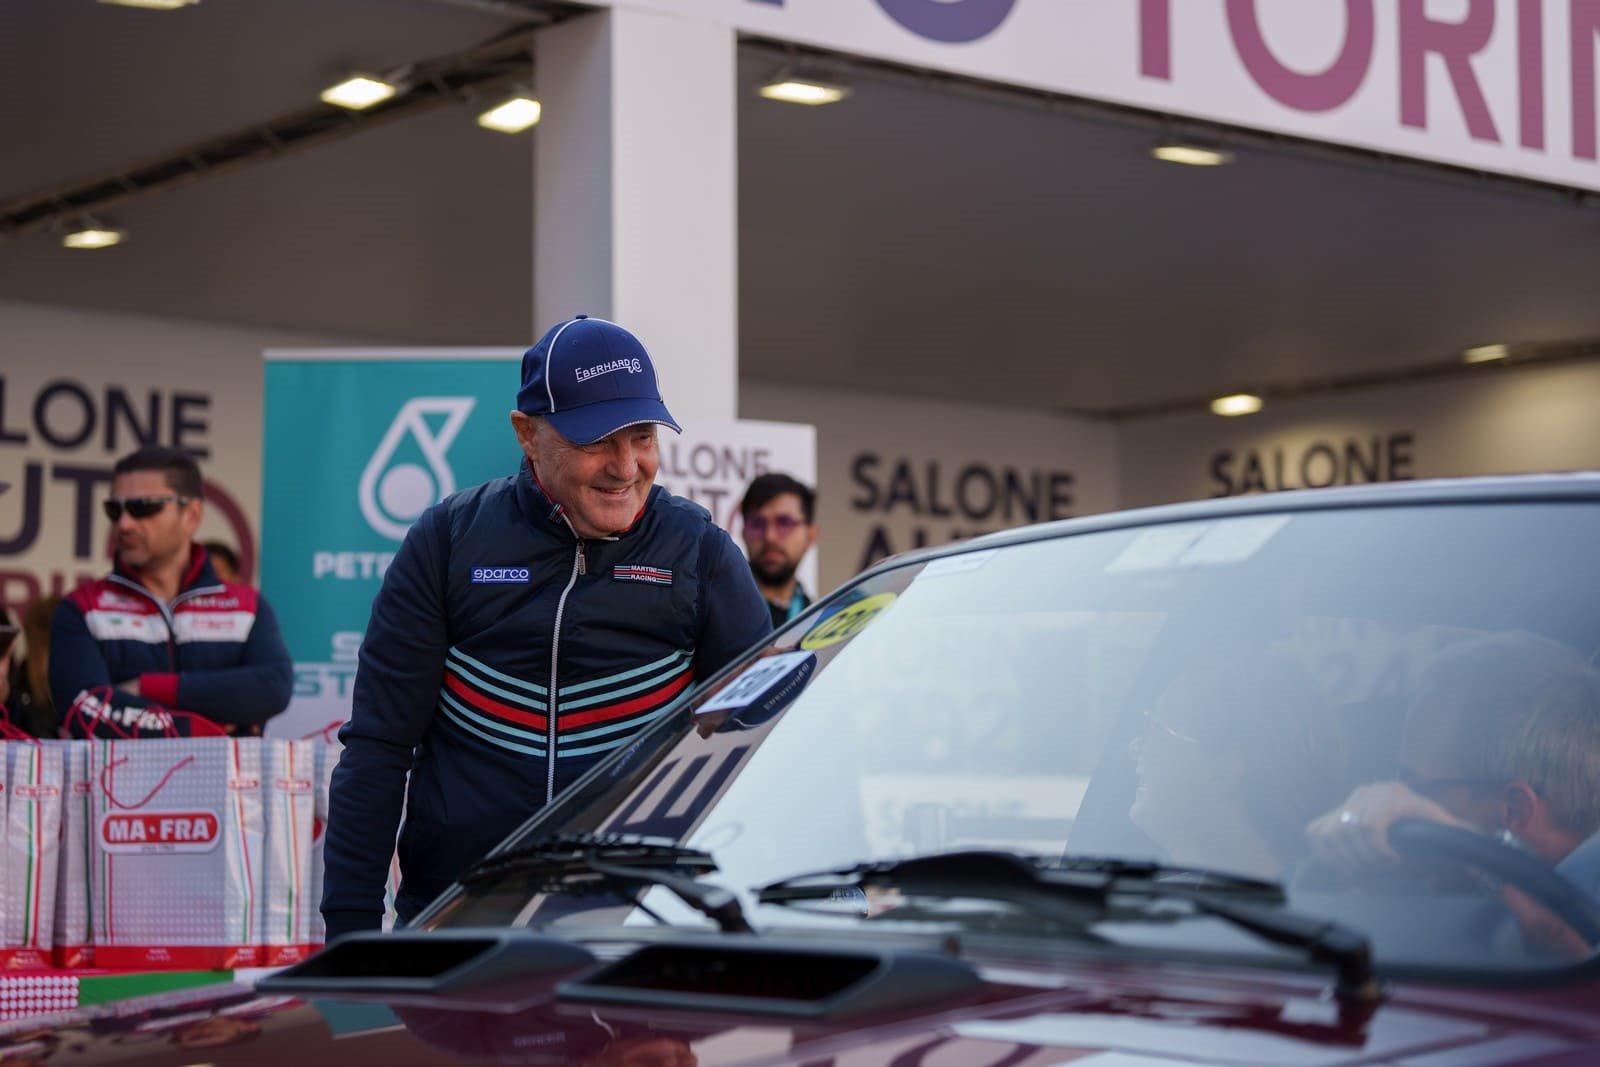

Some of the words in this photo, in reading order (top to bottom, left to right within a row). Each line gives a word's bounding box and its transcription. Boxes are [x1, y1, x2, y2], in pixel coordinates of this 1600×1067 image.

[1138, 0, 1600, 161] ORI
[659, 444, 769, 480] LONE
[1210, 431, 1415, 498] SALONE
[852, 452, 1074, 522] SALONE
[474, 568, 529, 583] sparco
[631, 565, 657, 573] MARTINI
[631, 574, 657, 582] RACING
